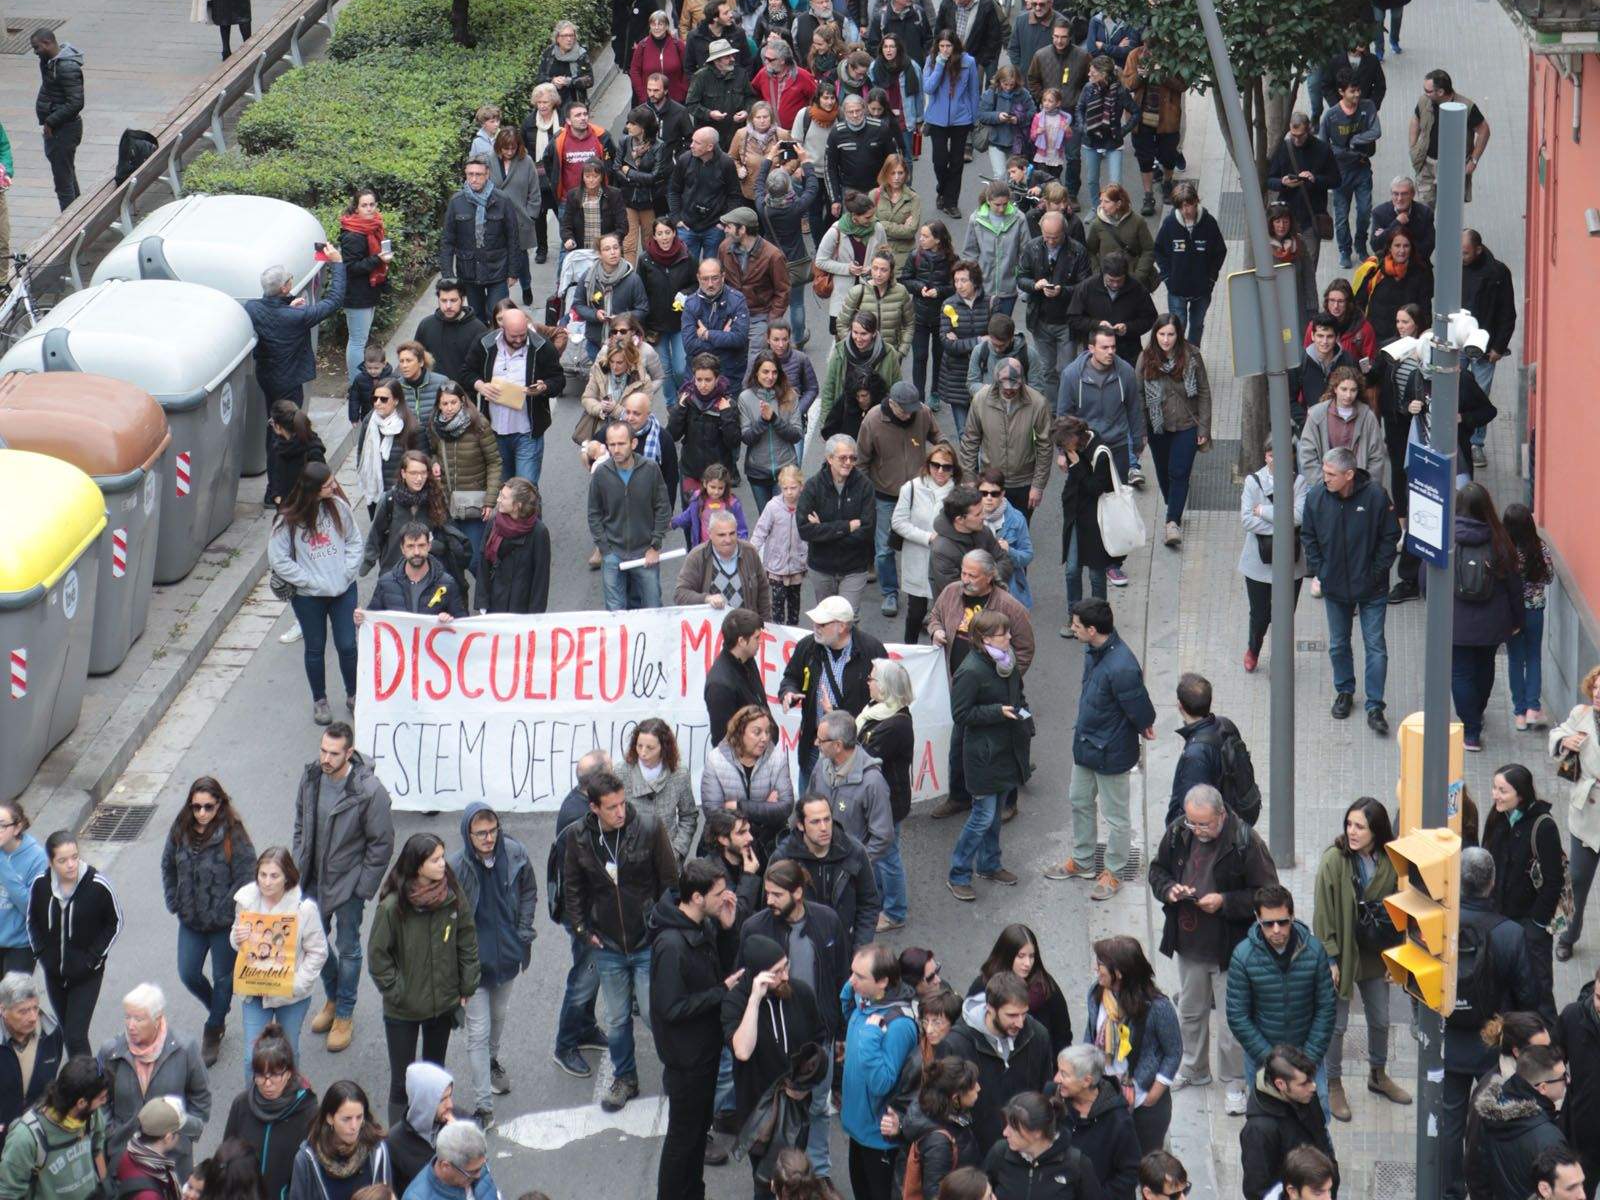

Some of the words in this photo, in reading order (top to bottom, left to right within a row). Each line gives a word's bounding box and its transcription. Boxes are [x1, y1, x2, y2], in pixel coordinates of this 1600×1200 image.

[309, 544, 337, 560] WALES
[373, 621, 628, 703] DISCULPEU
[631, 631, 668, 700] les
[372, 720, 486, 797] ESTEM
